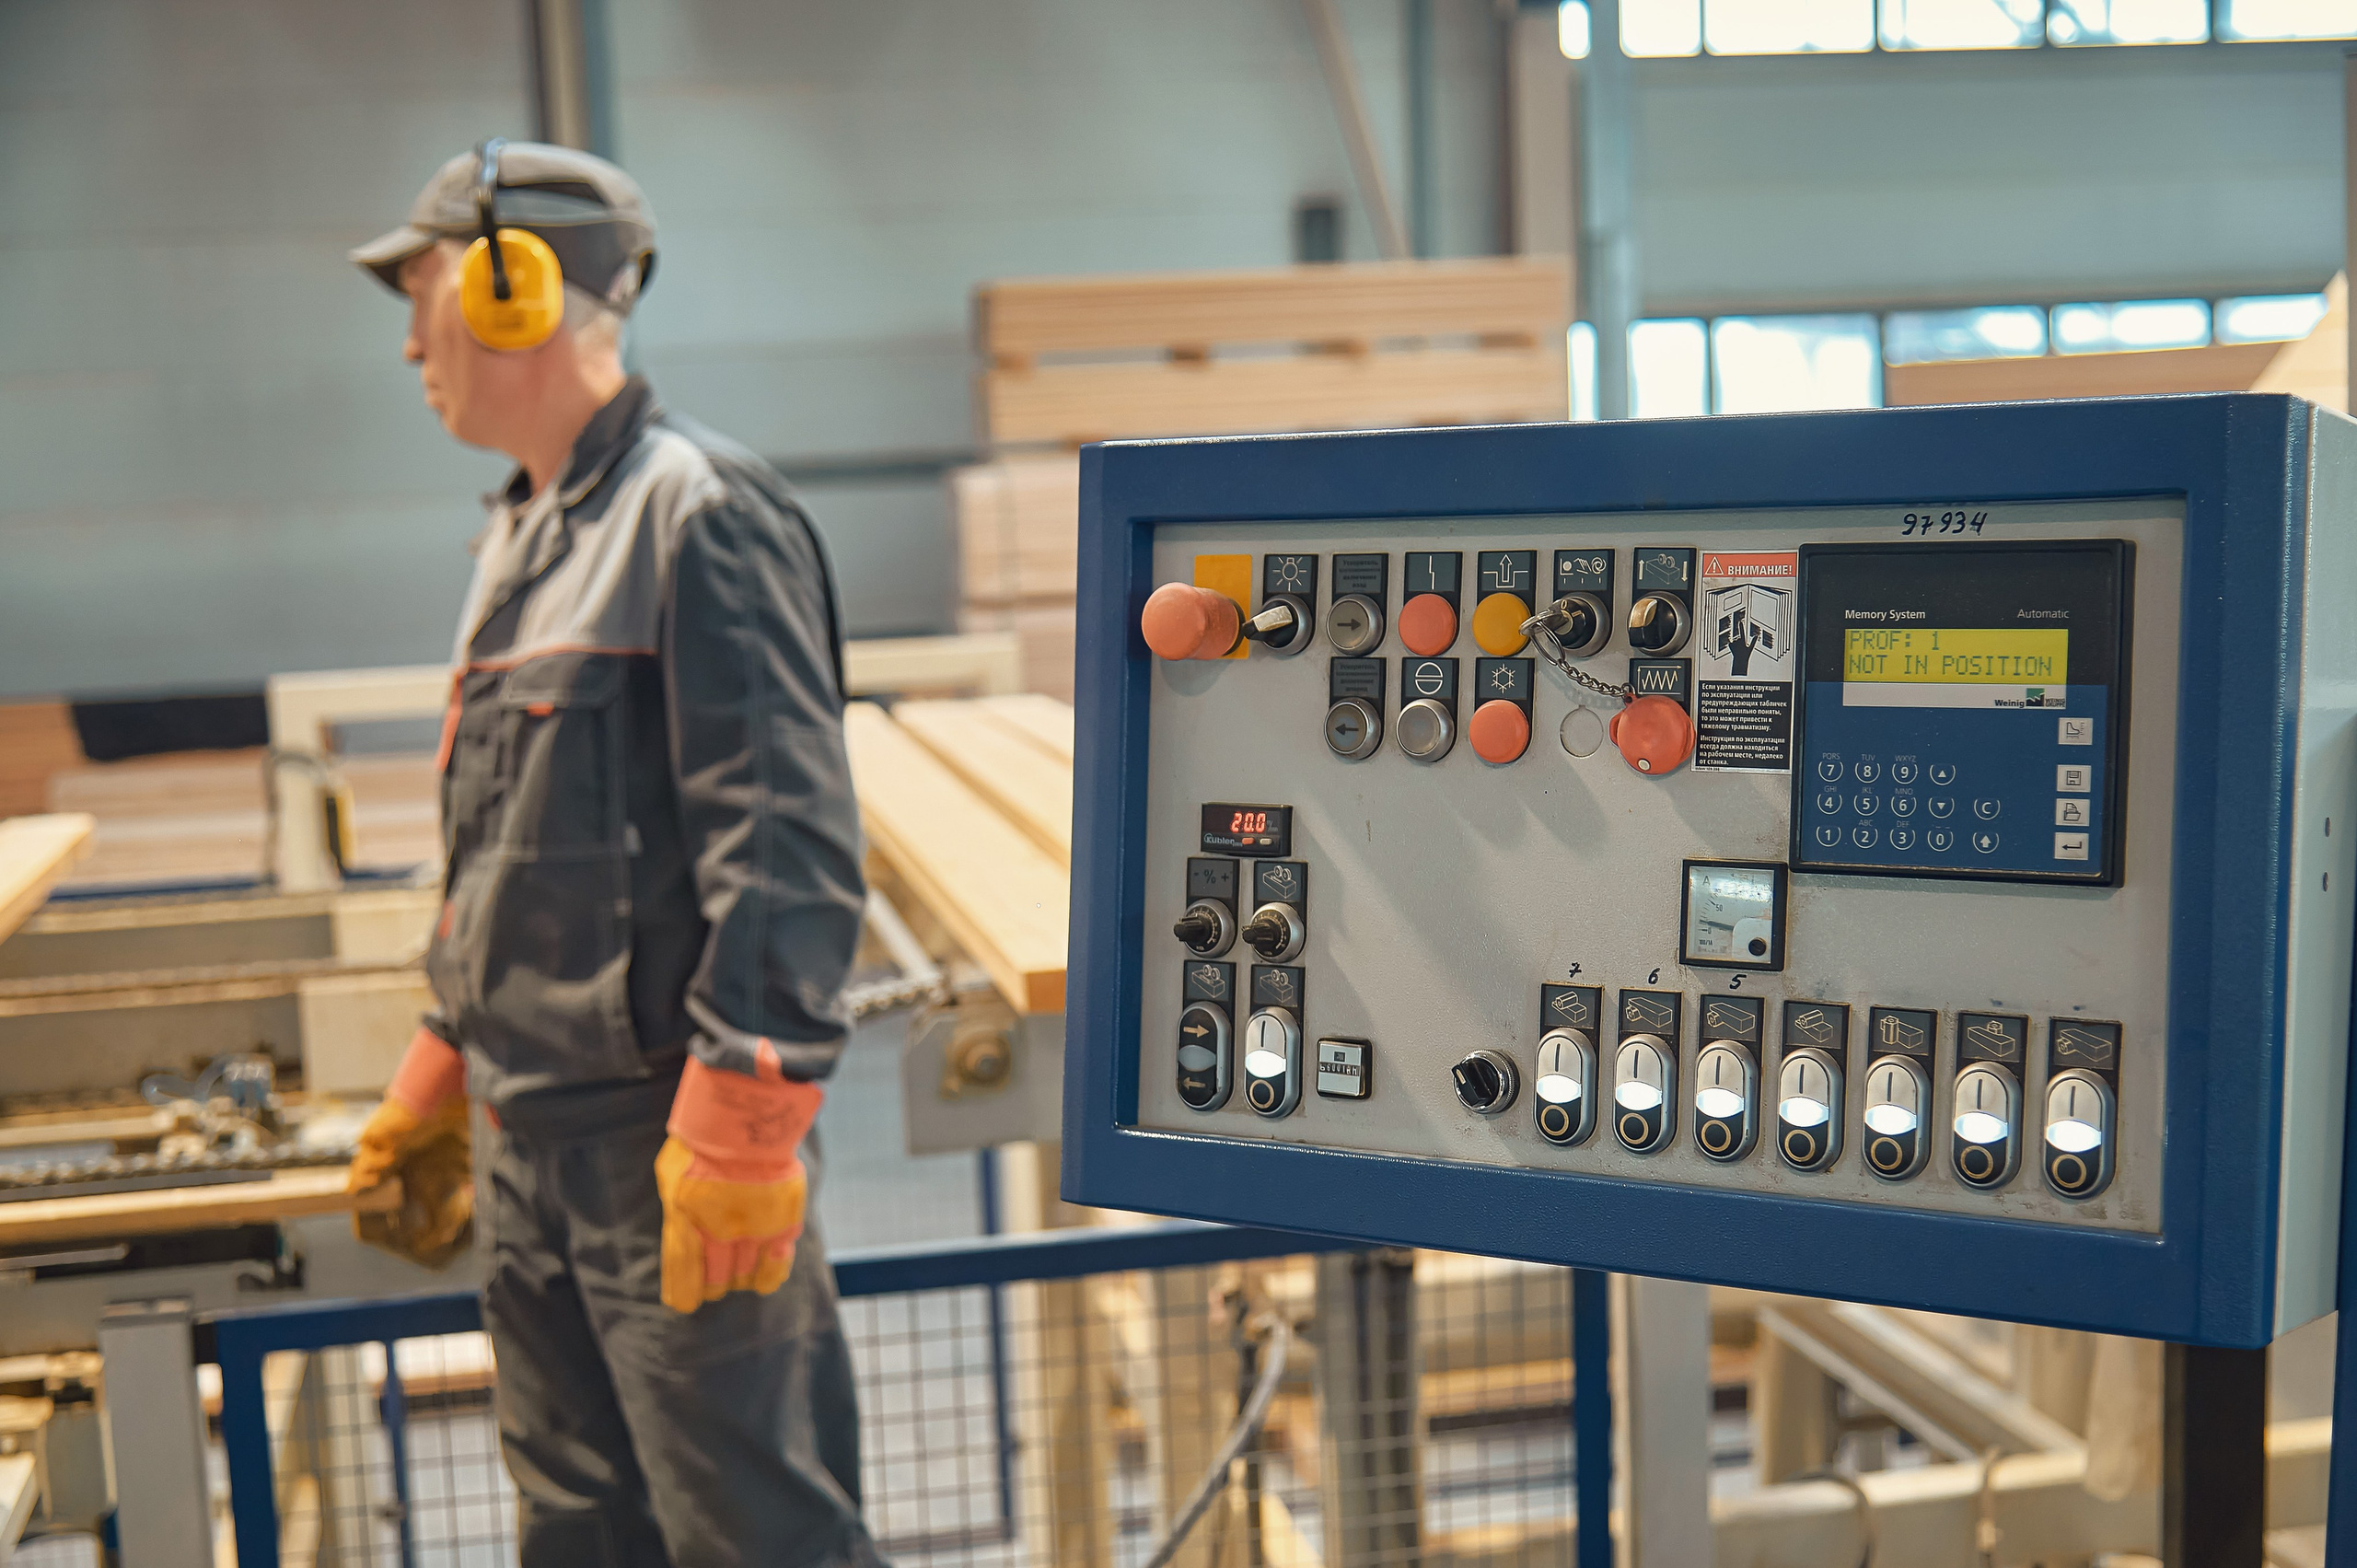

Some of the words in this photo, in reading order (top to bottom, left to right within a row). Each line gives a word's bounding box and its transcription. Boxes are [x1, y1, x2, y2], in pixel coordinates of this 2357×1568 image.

[1727, 565, 1792, 575] ВНИМАНИЕ!
[1845, 610, 1887, 621] Memory
[1889, 610, 1926, 621] System
[2017, 610, 2070, 619] Automatic
[1850, 631, 1910, 650] PROF:
[1932, 631, 1939, 650] 1
[1849, 655, 1887, 674] NOT
[1904, 655, 1928, 675] IN
[1943, 656, 2052, 676] POSITION
[1995, 700, 2025, 708] Weinig
[1827, 765, 1835, 775] 7
[1864, 766, 1871, 777] 8
[1901, 767, 1909, 778] 9
[1825, 797, 1833, 808] 4
[1863, 798, 1870, 810] 5
[1898, 799, 1907, 811] 6
[1981, 802, 1991, 815] C
[1230, 811, 1266, 833] 20.0
[1825, 830, 1831, 841] 1
[1862, 831, 1869, 842] 2
[1898, 832, 1906, 844] 3
[1936, 833, 1945, 845] 0
[1702, 876, 1711, 886] A
[1569, 962, 1582, 978] 7
[1648, 968, 1661, 985] 6
[1729, 973, 1747, 990] 5
